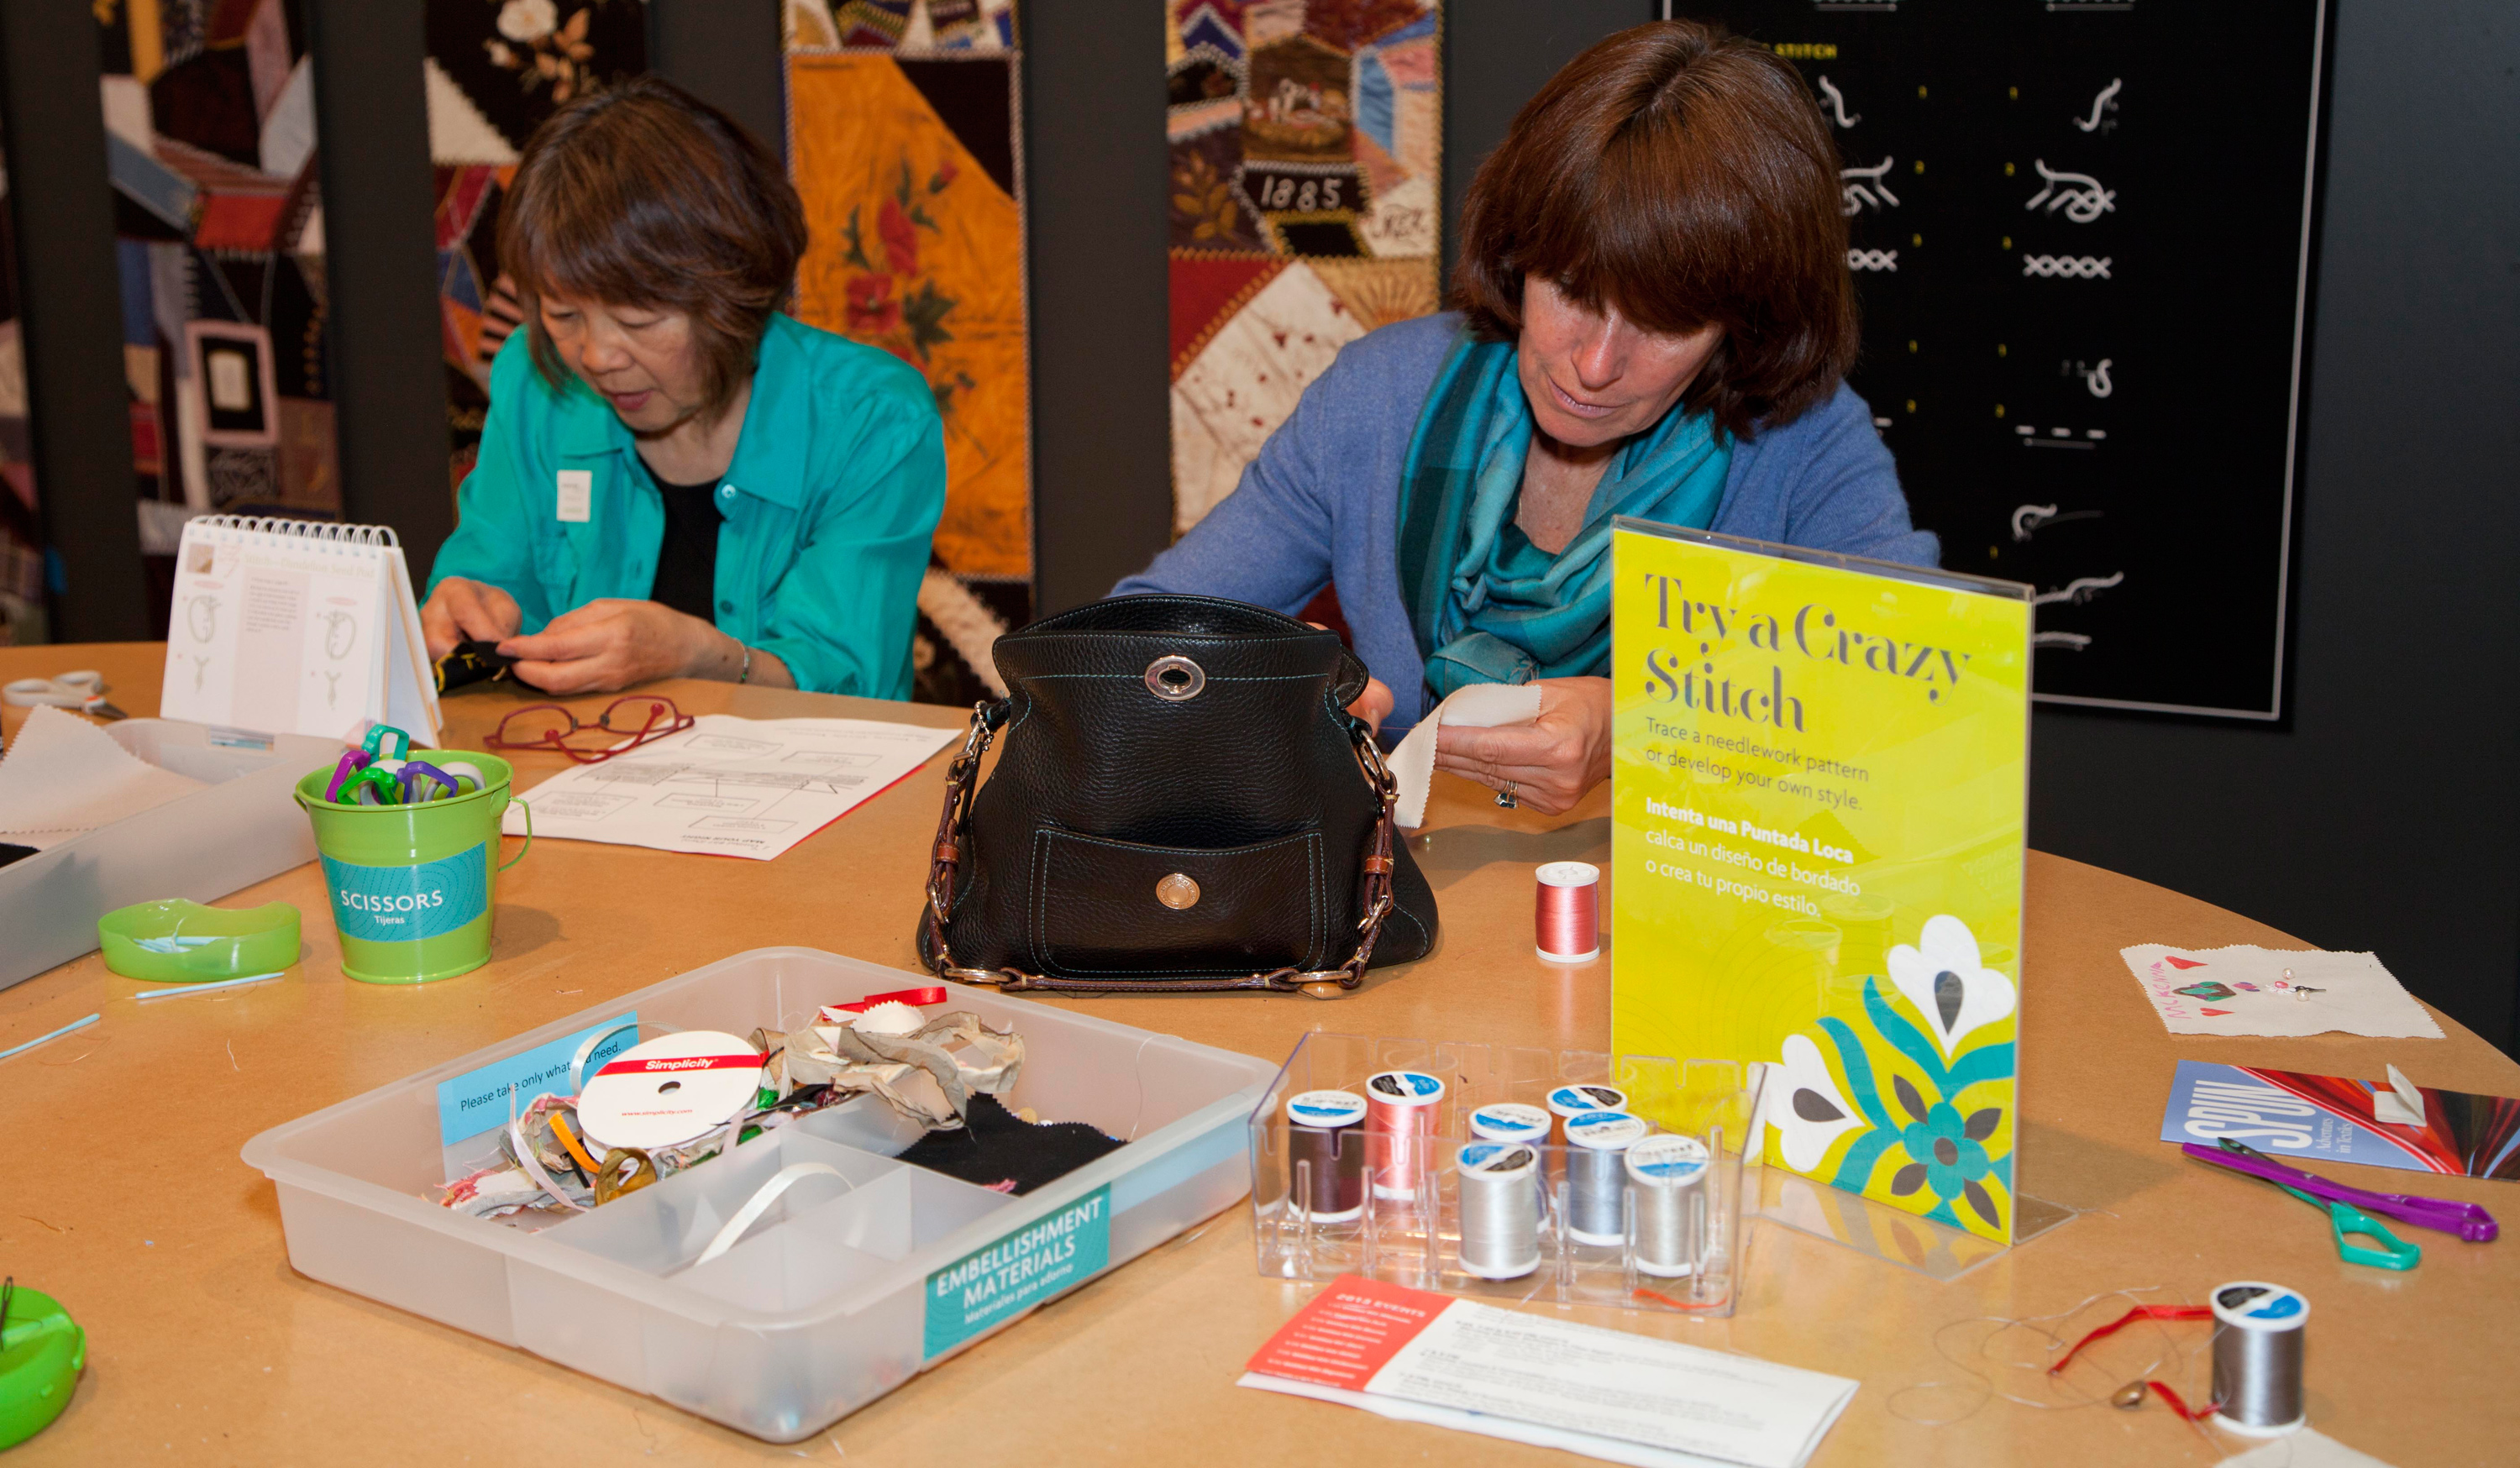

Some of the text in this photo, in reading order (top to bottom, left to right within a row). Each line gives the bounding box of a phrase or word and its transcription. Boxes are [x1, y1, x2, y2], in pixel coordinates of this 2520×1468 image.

[1260, 175, 1343, 212] 1885
[1646, 573, 1972, 706] Try a Crazy
[1645, 648, 1809, 733] Stitch
[1646, 716, 1869, 783] Trace a needlework pattern
[1646, 748, 1863, 810] or develop your own style.
[1646, 796, 1855, 864] Intenta una Puntada Loca
[1646, 829, 1861, 897] calca un diseño de bordado
[1646, 859, 1821, 918] o crea tu propio estilo.
[340, 889, 444, 913] SCISSORS
[374, 915, 405, 926] Tijeras
[460, 1090, 494, 1111] Please
[496, 1081, 519, 1098] take
[522, 1071, 544, 1089] only
[545, 1060, 571, 1079] what
[593, 1041, 622, 1061] need.
[645, 1057, 714, 1071] Simplicity
[622, 1109, 693, 1117] www.simplicity.com
[2184, 1079, 2316, 1149] SPUN
[2315, 1117, 2334, 1152] Adventures
[937, 1196, 1103, 1298] EMBELLISHMENT
[963, 1234, 1076, 1310] MATERIALS
[964, 1263, 1074, 1325] Materiales para adorno
